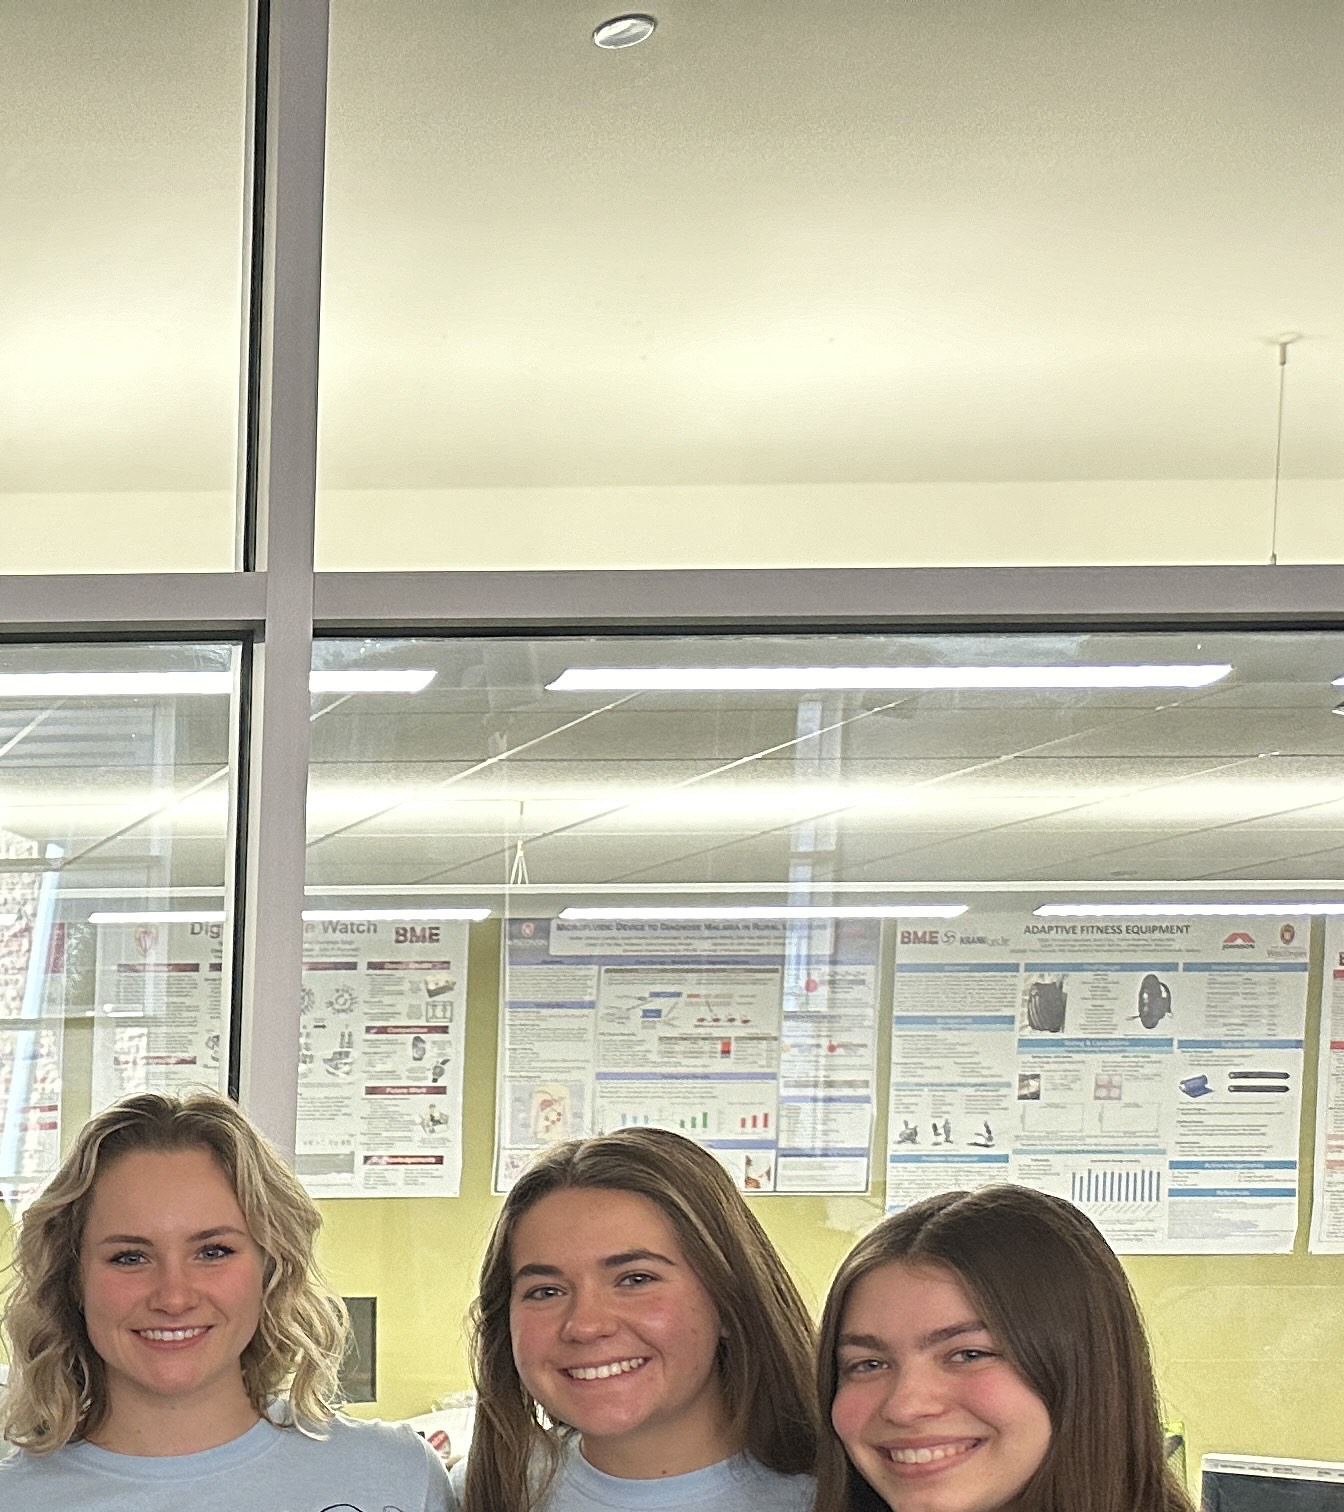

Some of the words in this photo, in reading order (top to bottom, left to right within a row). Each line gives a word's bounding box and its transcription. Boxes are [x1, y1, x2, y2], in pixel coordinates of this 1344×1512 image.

[321, 919, 378, 935] Watch
[1023, 925, 1078, 935] ADAPTIVE
[1080, 925, 1124, 935] FITNESS
[1126, 924, 1191, 935] EQUIPMENT
[393, 926, 441, 944] BME
[900, 930, 940, 945] BME
